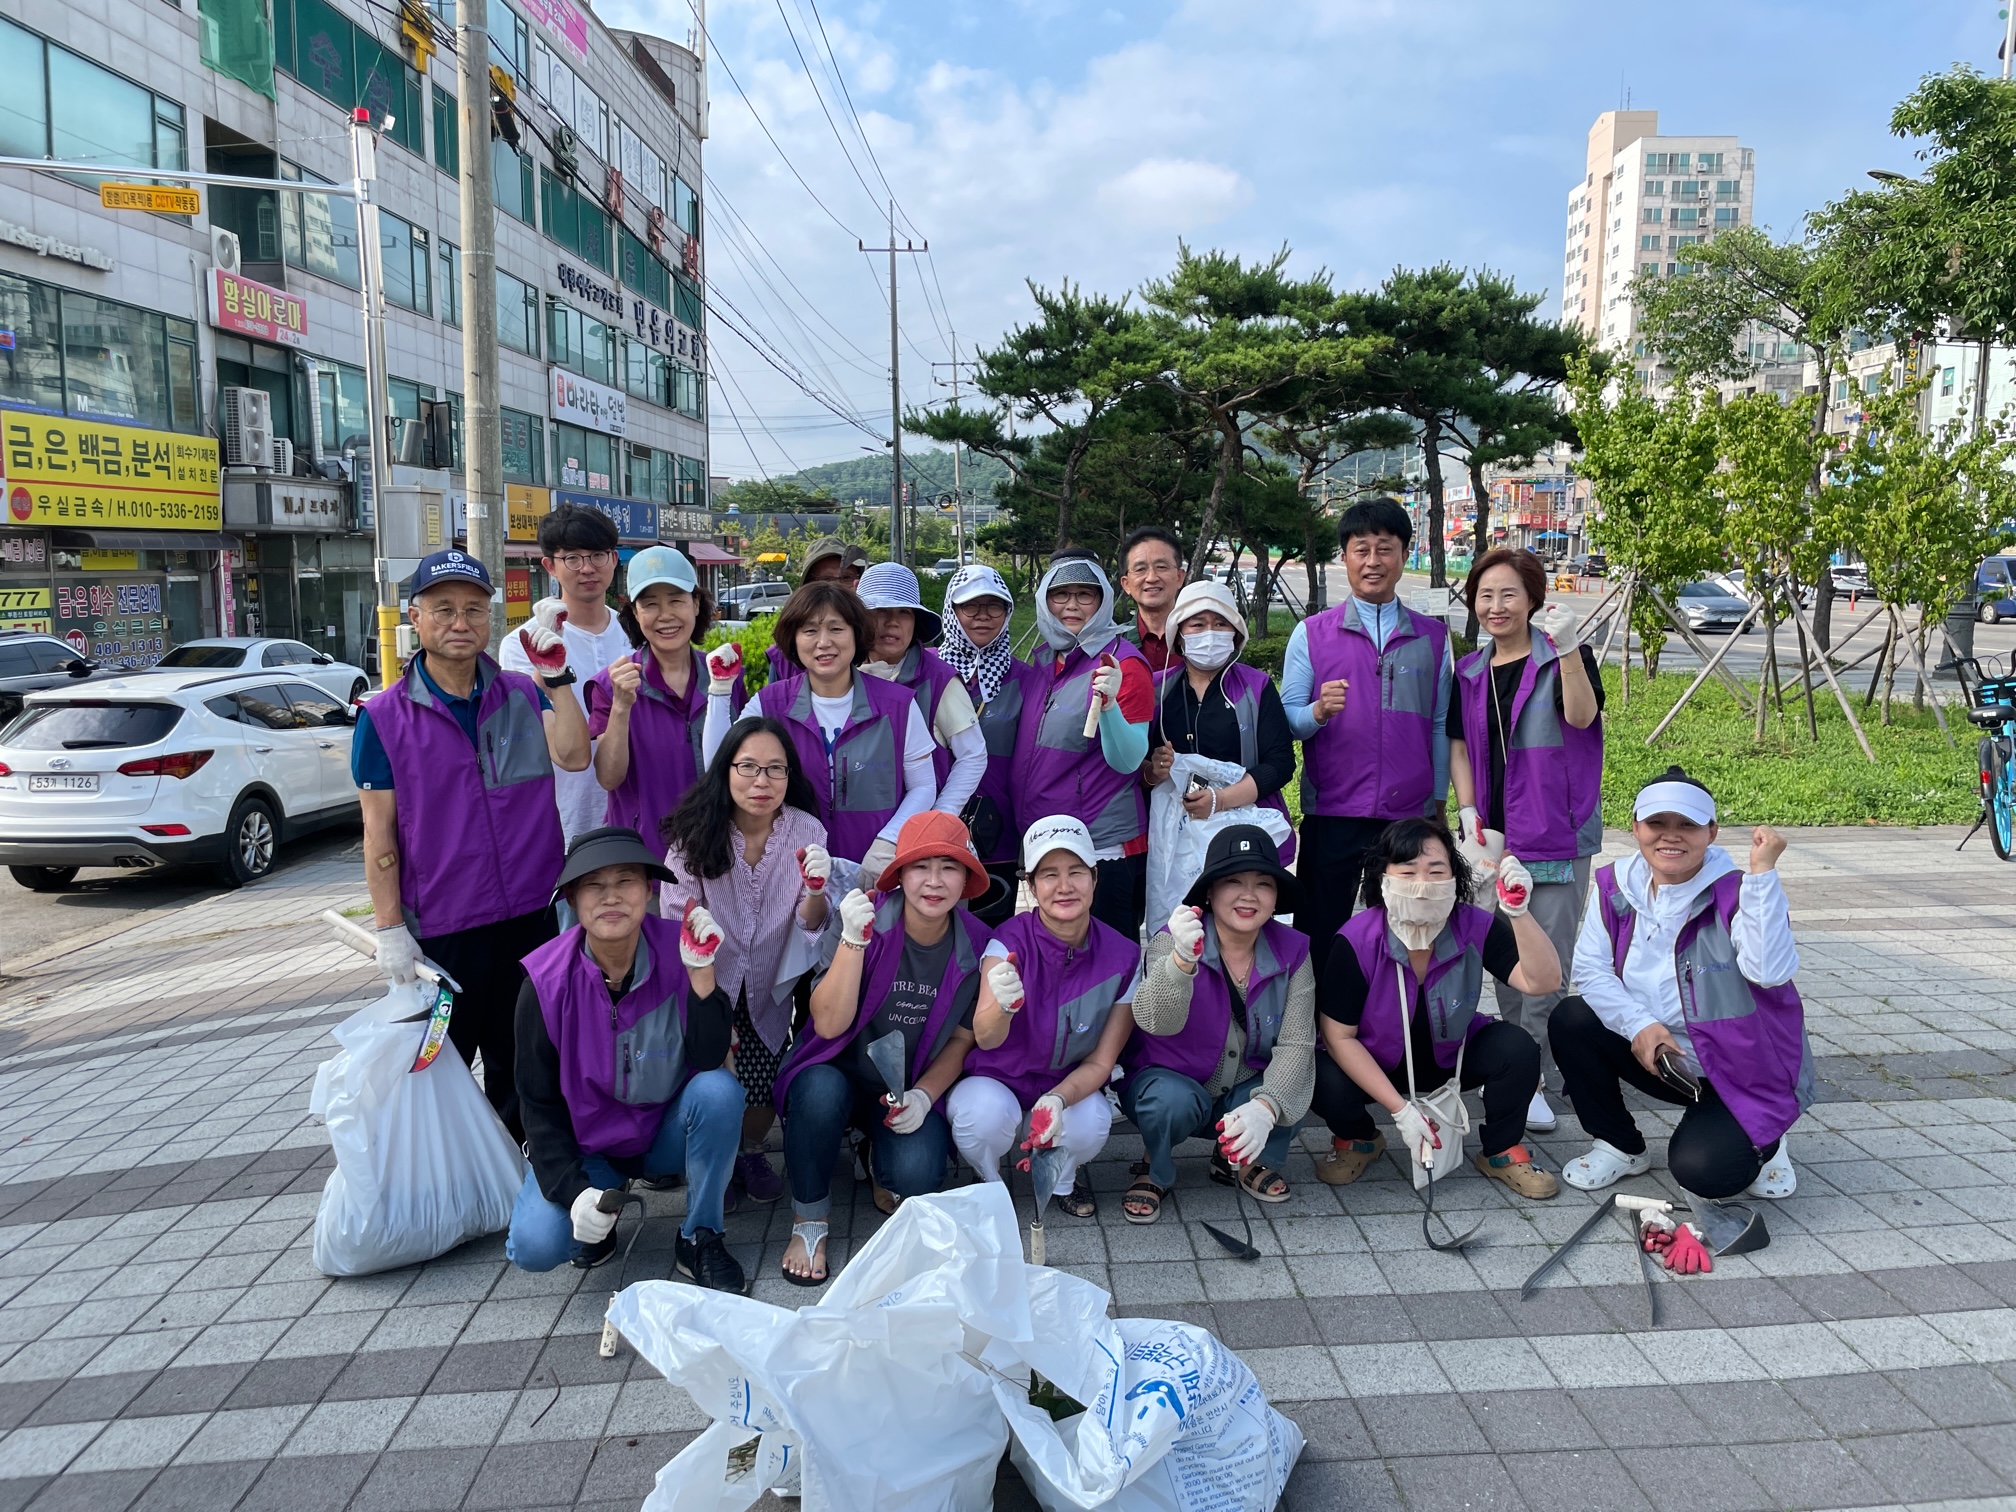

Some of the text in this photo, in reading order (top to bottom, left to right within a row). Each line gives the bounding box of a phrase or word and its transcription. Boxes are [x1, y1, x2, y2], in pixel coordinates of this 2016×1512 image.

[155, 194, 175, 209] CCTV
[223, 277, 302, 332] 황실아로마
[8, 425, 171, 480] 금,은,백금,분석
[176, 445, 217, 463] 회수기제작
[117, 500, 219, 521] H.010-5336-2159
[660, 508, 678, 529] 블라인드
[431, 562, 480, 574] BAKERSFIELD
[90, 585, 114, 616] 회수
[116, 584, 161, 615] 전문업체
[95, 637, 163, 656] 480-1313
[64, 777, 92, 788] 1126
[889, 1013, 902, 1022] UN
[1178, 1462, 1207, 1472] recycling.
[1182, 1469, 1208, 1480] Garbage
[1209, 1466, 1224, 1474] must
[1225, 1462, 1233, 1470] be
[1234, 1458, 1244, 1468] put
[1183, 1479, 1201, 1489] 20:00
[1202, 1476, 1214, 1484] and
[1187, 1488, 1203, 1497] Fines
[1216, 1480, 1234, 1489] million
[1209, 1490, 1234, 1501] imposed
